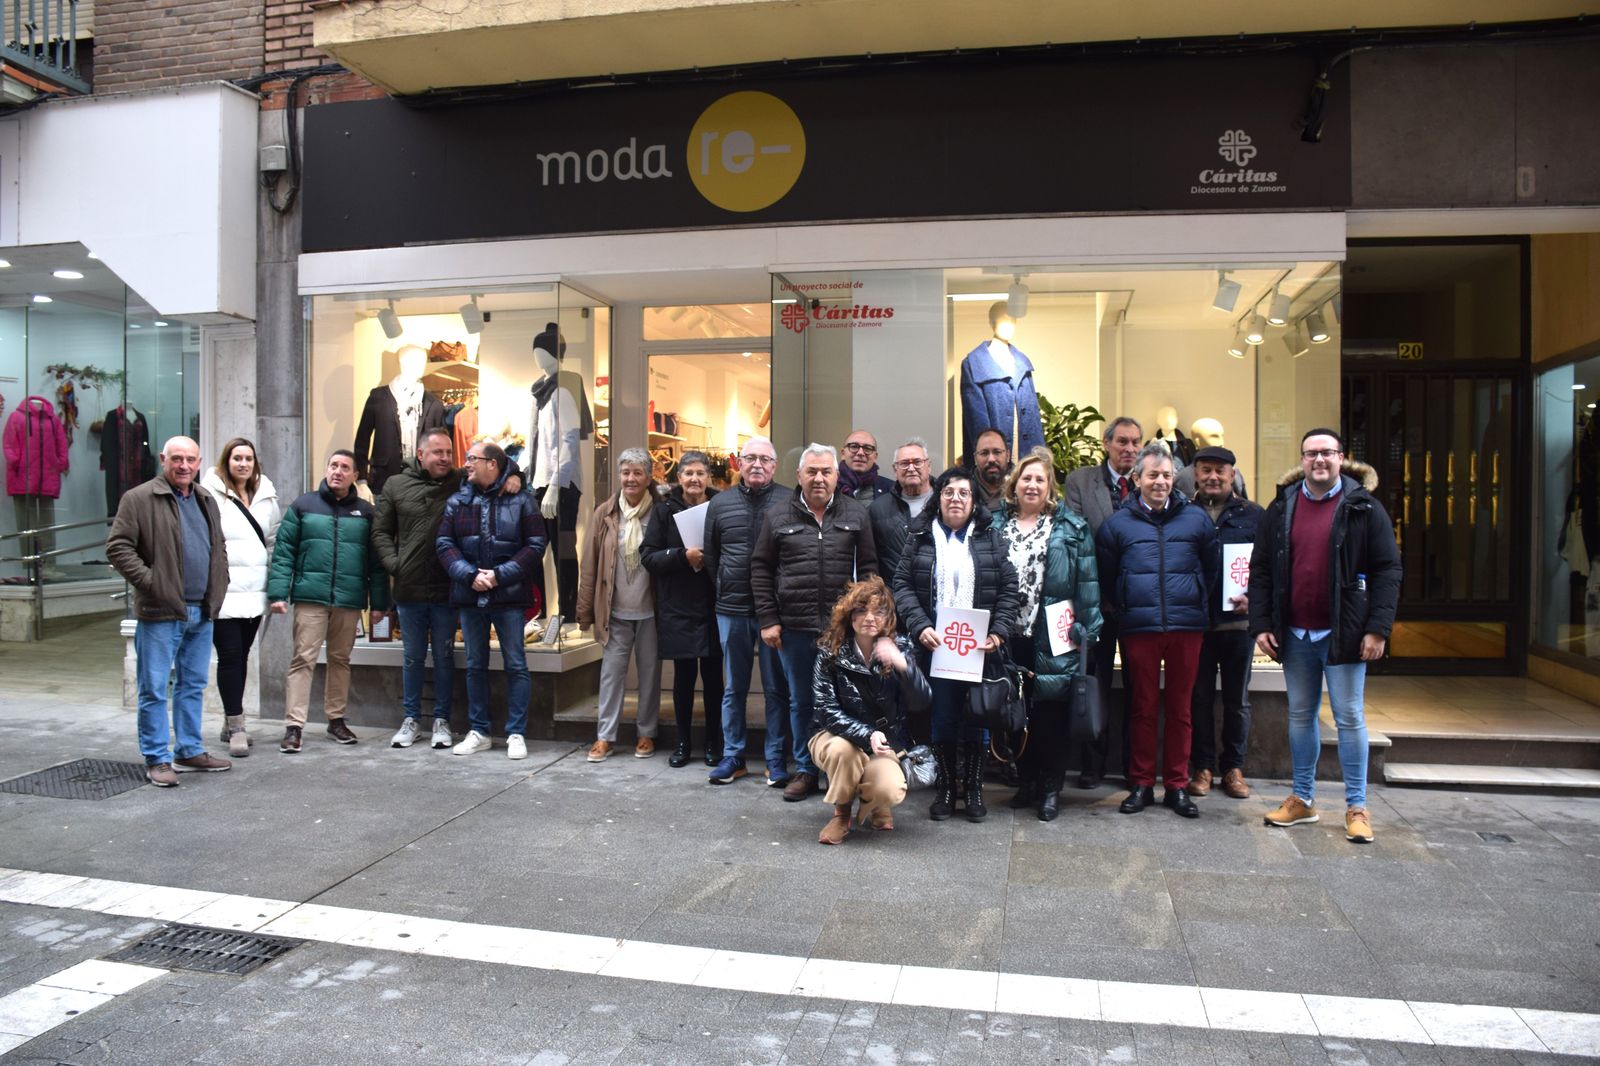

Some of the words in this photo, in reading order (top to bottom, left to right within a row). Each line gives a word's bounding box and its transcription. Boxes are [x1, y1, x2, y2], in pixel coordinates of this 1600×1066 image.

[536, 137, 673, 186] moda
[701, 130, 791, 176] re-
[1199, 168, 1278, 184] Cáritas
[1190, 185, 1236, 194] Diocesana
[1238, 185, 1249, 193] de
[1251, 184, 1287, 193] Zamora
[793, 282, 828, 292] proyecto
[829, 281, 852, 290] social
[853, 281, 864, 289] de
[812, 304, 895, 320] Cáritas
[816, 322, 848, 330] Diocesana
[1400, 344, 1422, 359] 20
